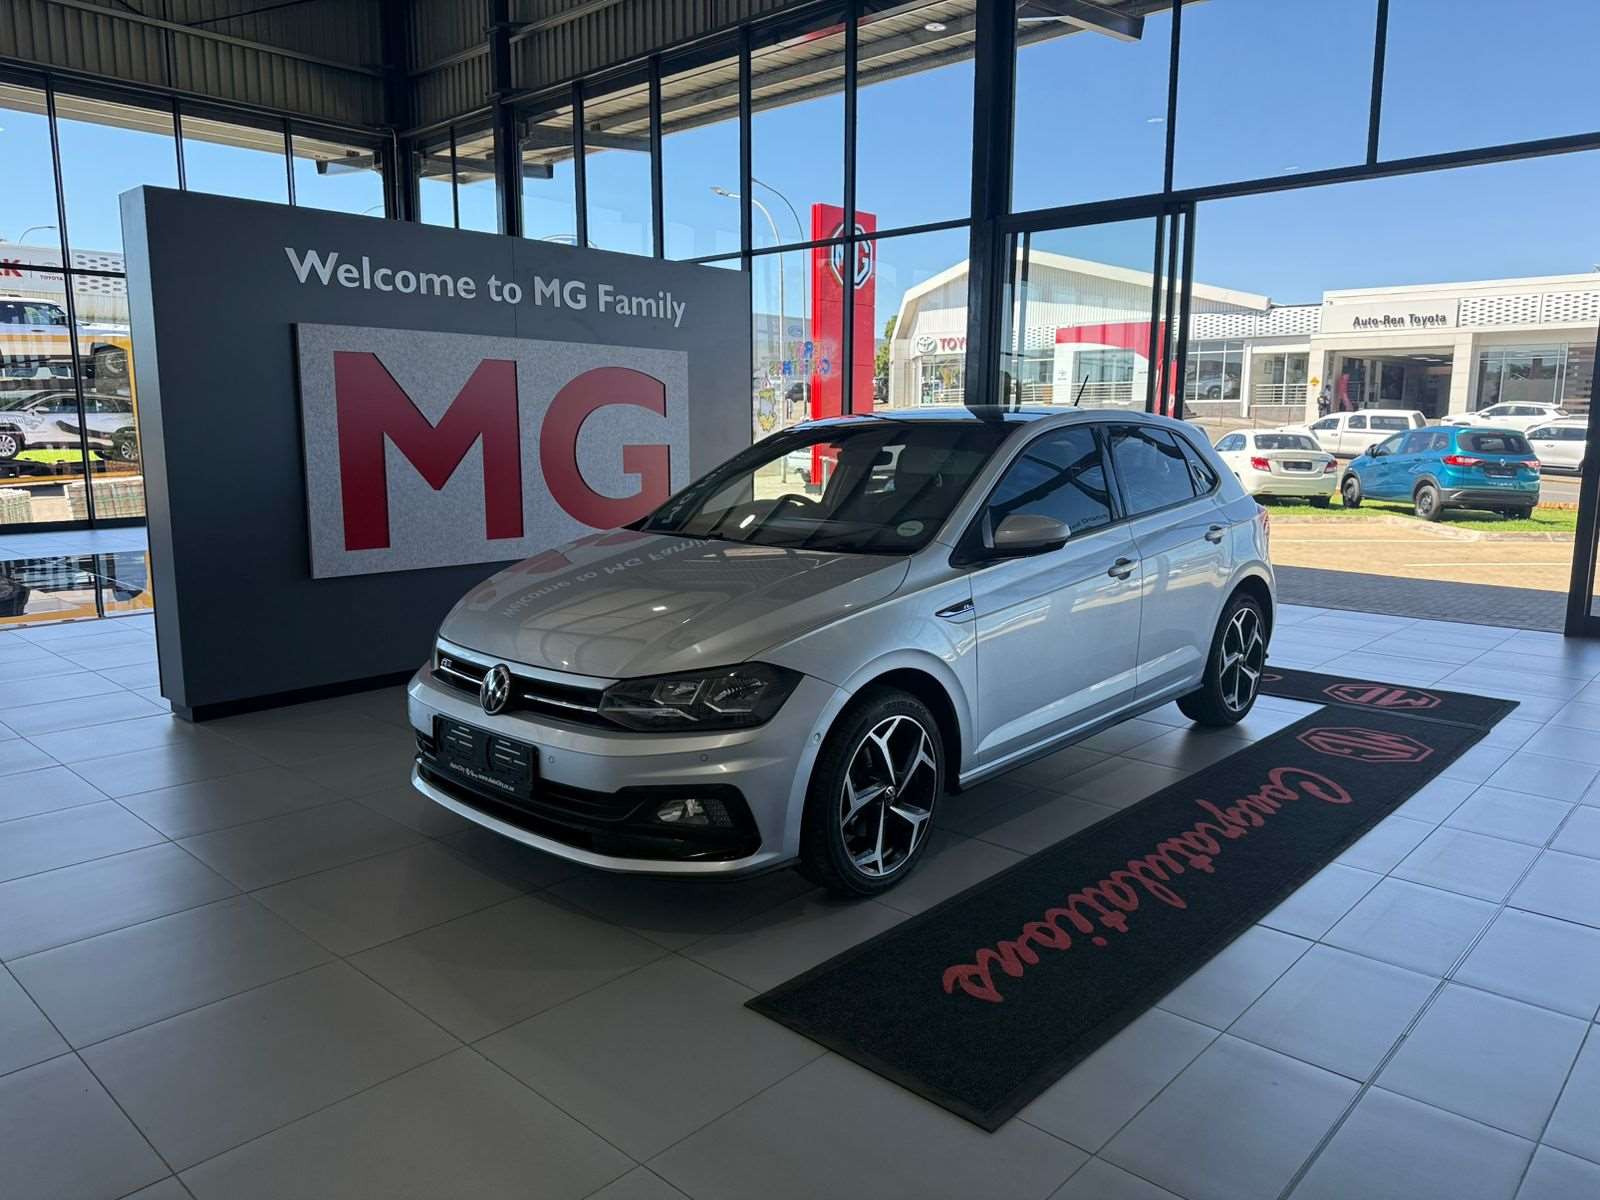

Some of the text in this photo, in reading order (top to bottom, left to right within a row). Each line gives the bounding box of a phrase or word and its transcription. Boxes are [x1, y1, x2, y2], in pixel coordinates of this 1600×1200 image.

[283, 247, 687, 328] Welcome to MG Family
[1353, 313, 1447, 328] Auto-Ren Toyota
[940, 336, 966, 352] TOY
[333, 350, 672, 550] MG
[942, 766, 1353, 1003] Congratulations
